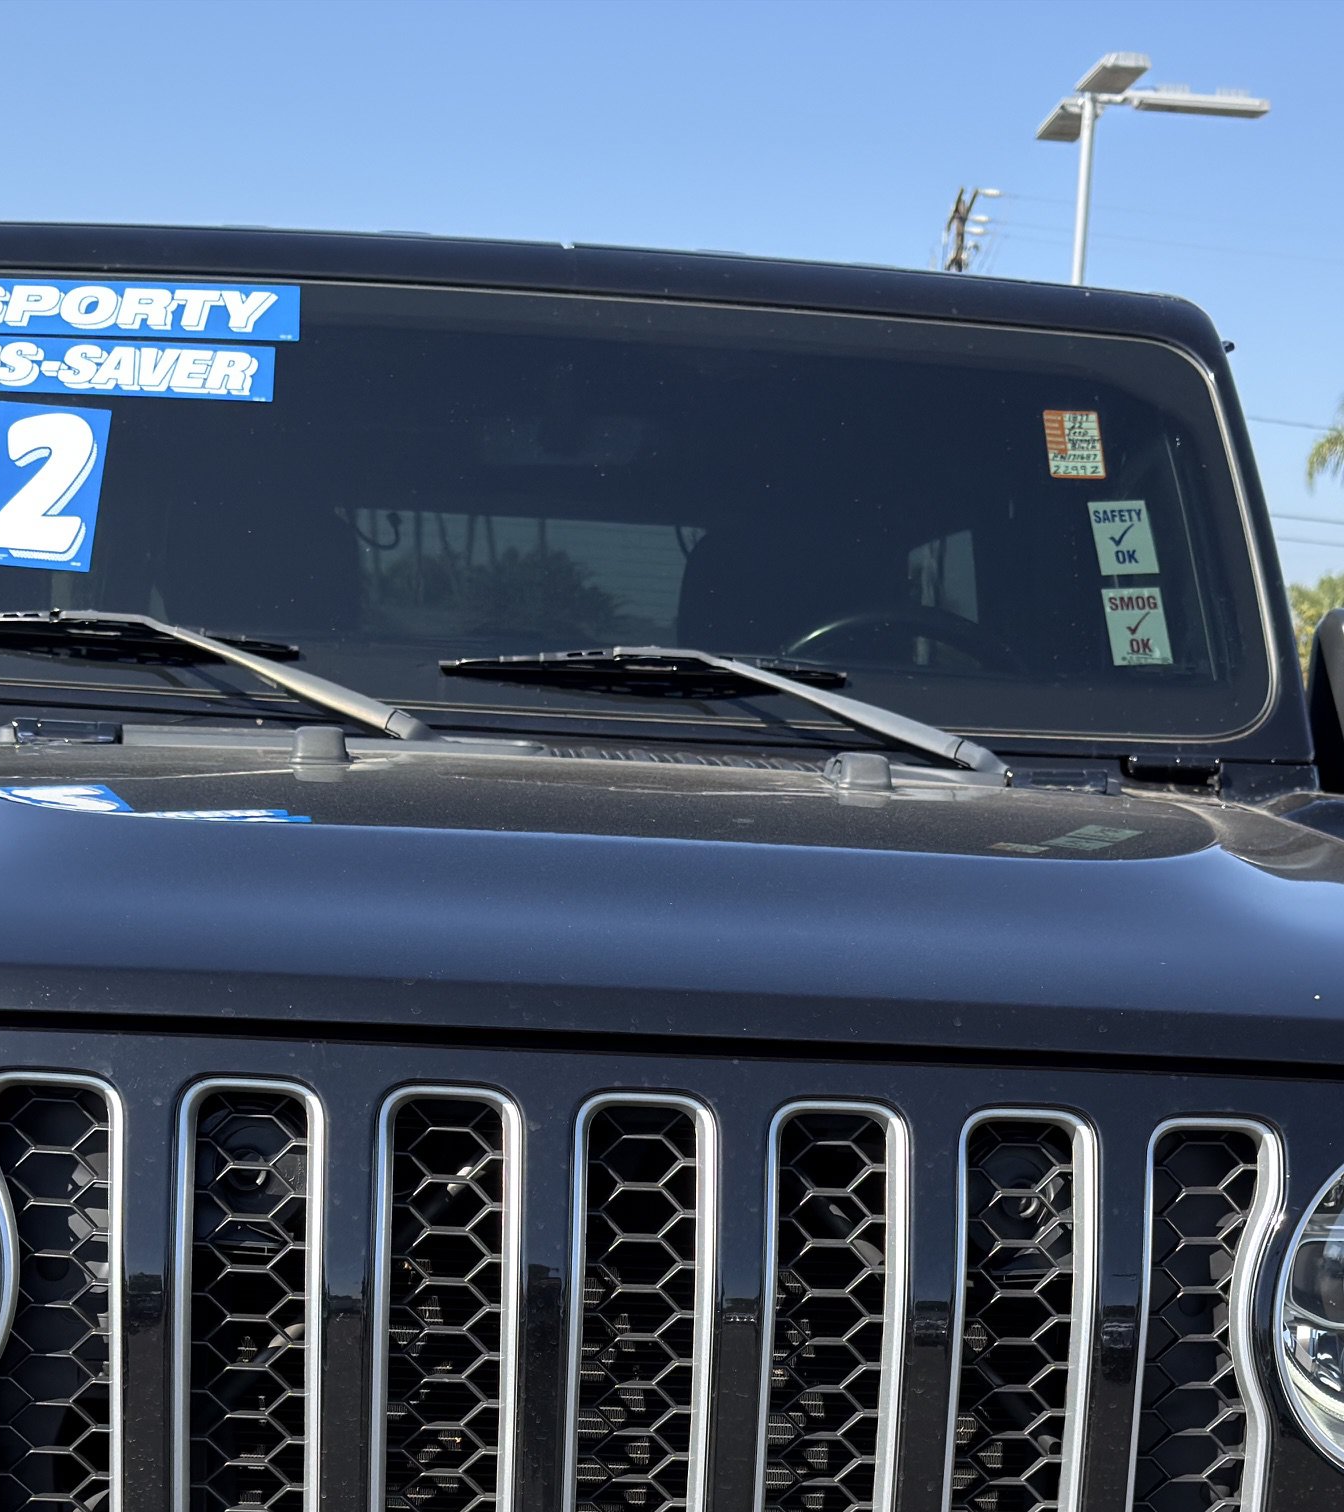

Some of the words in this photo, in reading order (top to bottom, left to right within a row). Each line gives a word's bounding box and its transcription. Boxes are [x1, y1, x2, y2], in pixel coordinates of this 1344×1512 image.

[1093, 508, 1142, 524] SAFETY
[1115, 549, 1139, 564] OK
[1108, 595, 1158, 611] SMOG
[1129, 638, 1153, 654] OK
